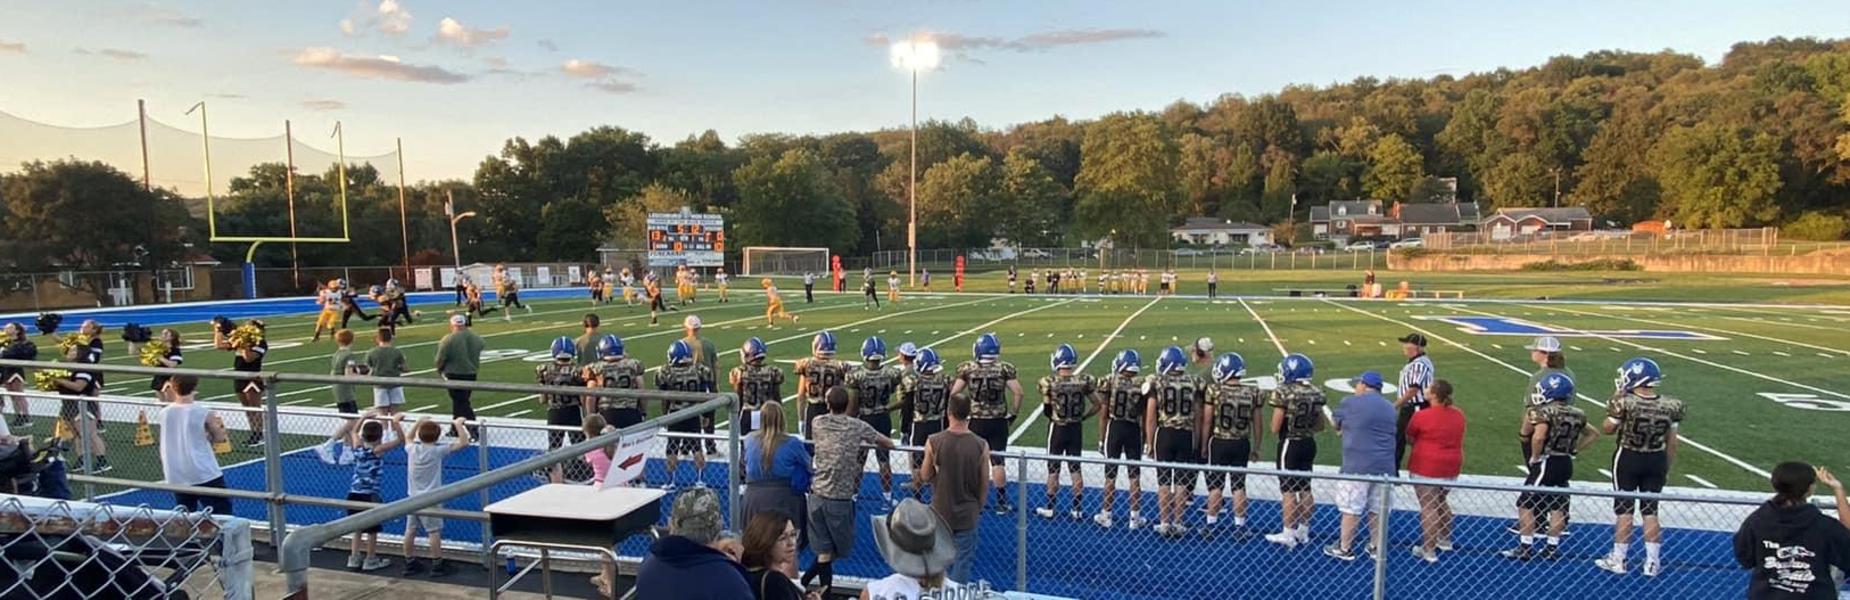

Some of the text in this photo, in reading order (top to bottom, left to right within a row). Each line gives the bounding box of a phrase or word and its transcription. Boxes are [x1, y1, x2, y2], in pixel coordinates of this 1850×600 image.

[972, 377, 999, 403] 75
[1164, 386, 1192, 416] 86
[1220, 402, 1250, 430] 65
[1633, 417, 1671, 449] 52
[1763, 540, 1780, 549] The
